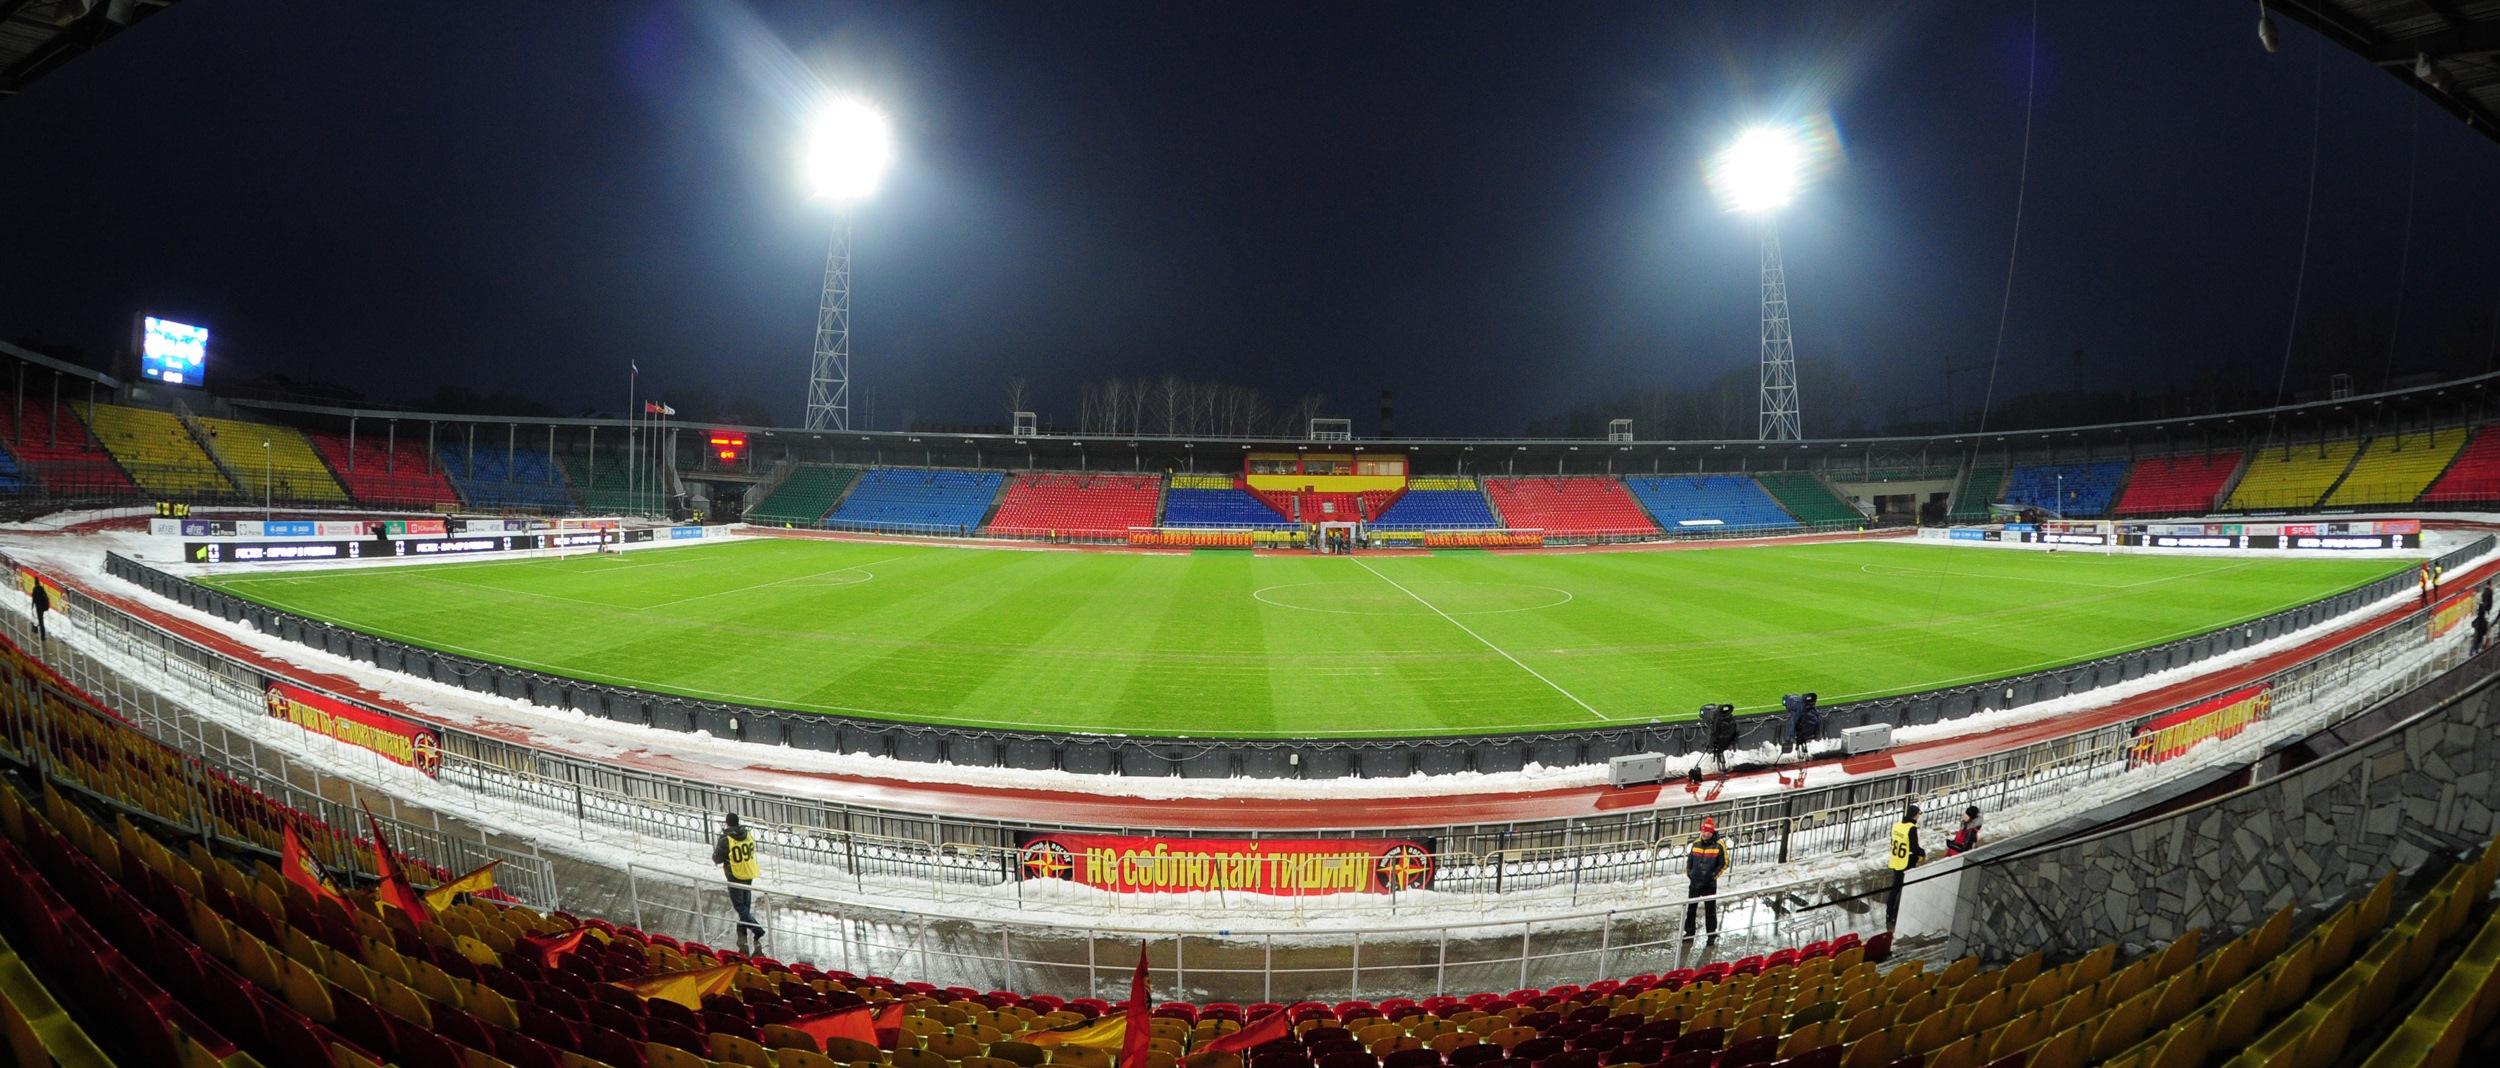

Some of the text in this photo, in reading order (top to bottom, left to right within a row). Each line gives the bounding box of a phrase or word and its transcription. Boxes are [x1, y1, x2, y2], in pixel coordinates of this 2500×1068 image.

[1086, 847, 1118, 885] не
[1123, 842, 1262, 892] соблюдай
[1267, 852, 1370, 892] тишину
